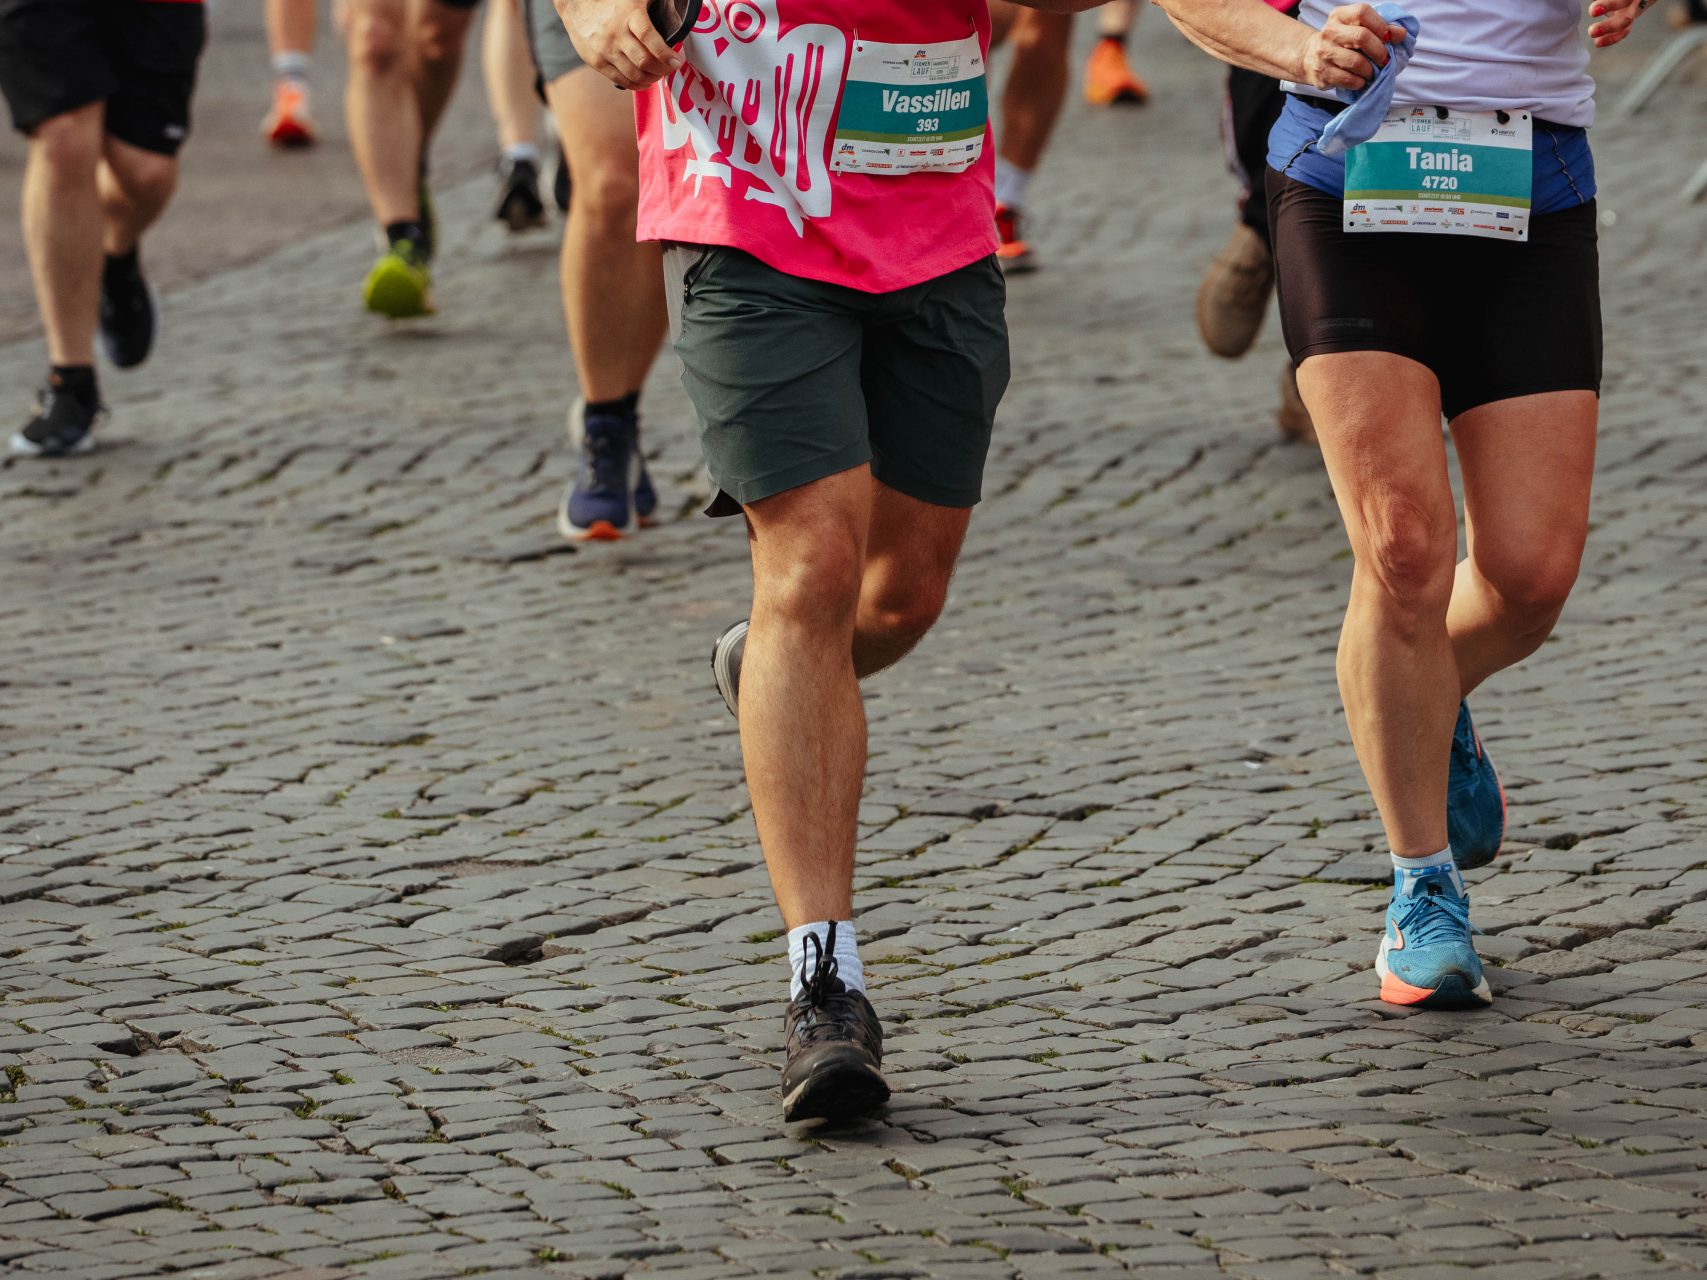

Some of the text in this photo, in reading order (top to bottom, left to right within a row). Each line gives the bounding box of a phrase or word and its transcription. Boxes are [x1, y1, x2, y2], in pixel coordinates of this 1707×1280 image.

[912, 68, 930, 76] LAUF
[882, 88, 971, 114] Vassillen
[916, 118, 940, 132] 393
[1406, 147, 1473, 172] Tania
[1422, 175, 1458, 190] 4720
